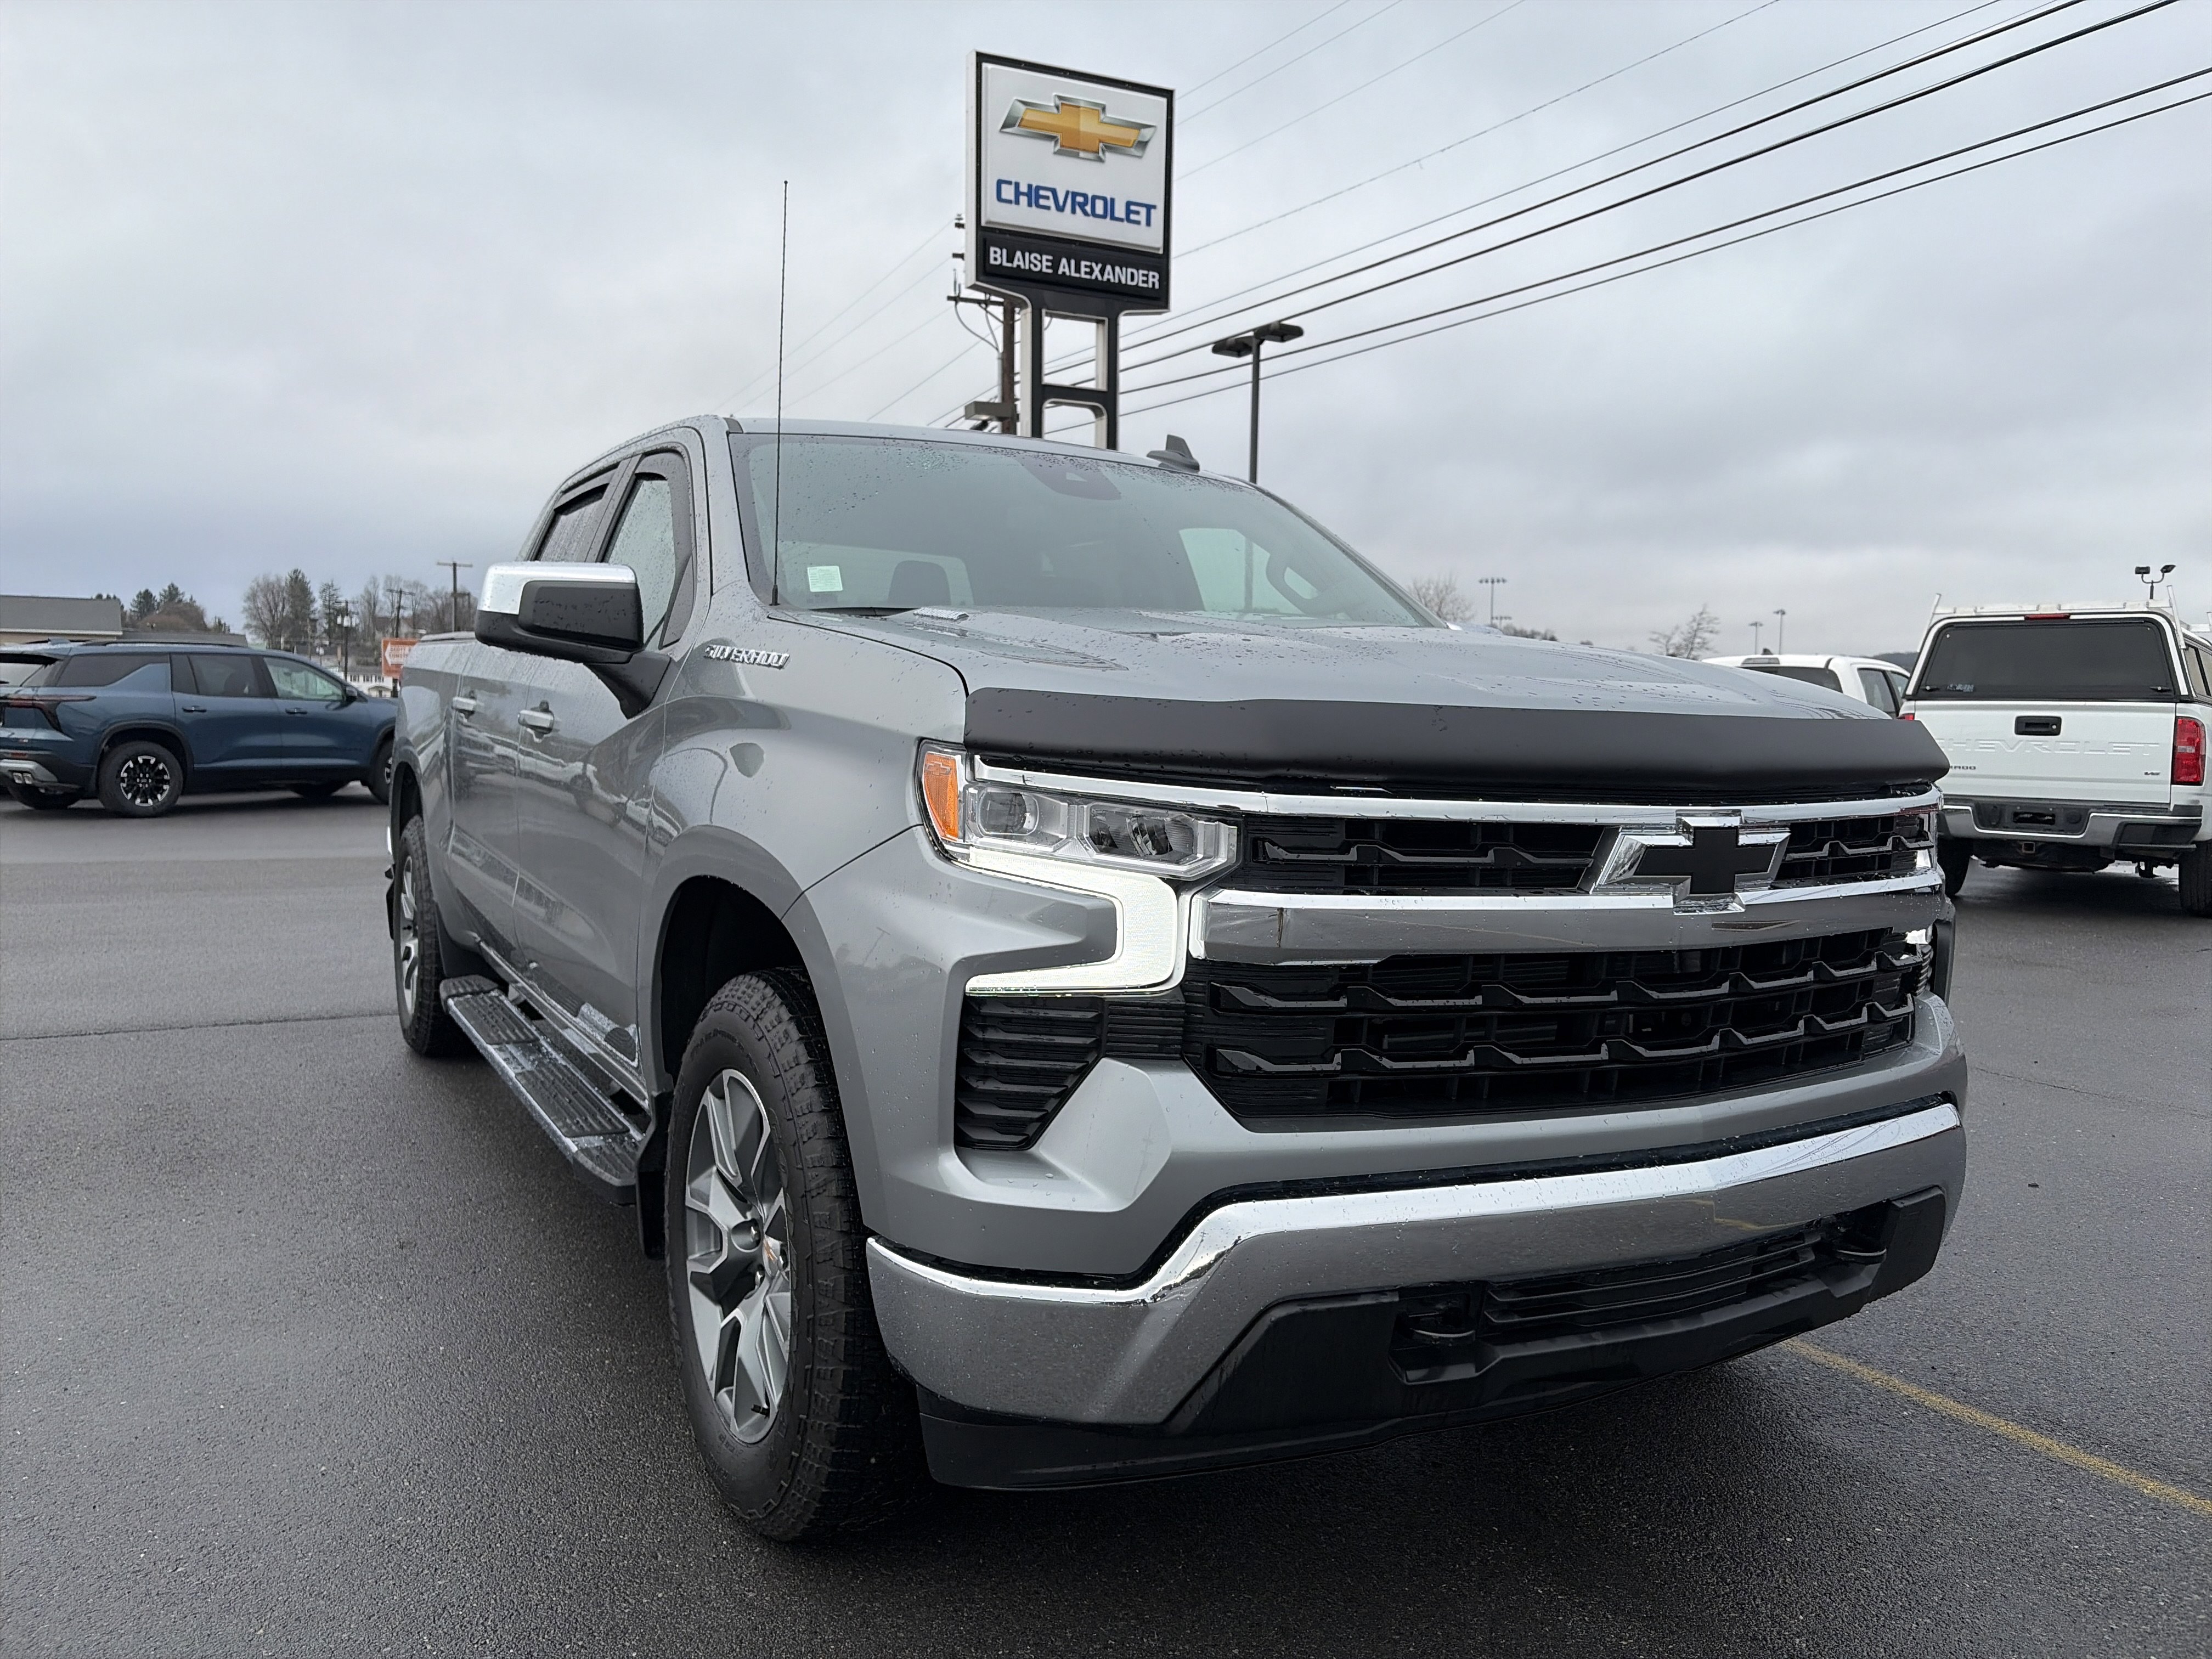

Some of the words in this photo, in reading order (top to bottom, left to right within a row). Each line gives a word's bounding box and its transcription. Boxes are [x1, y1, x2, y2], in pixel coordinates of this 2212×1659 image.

[996, 179, 1156, 227] CHEVROLET
[989, 246, 1053, 273] BLAISE
[1058, 257, 1160, 289] ALEXANDER
